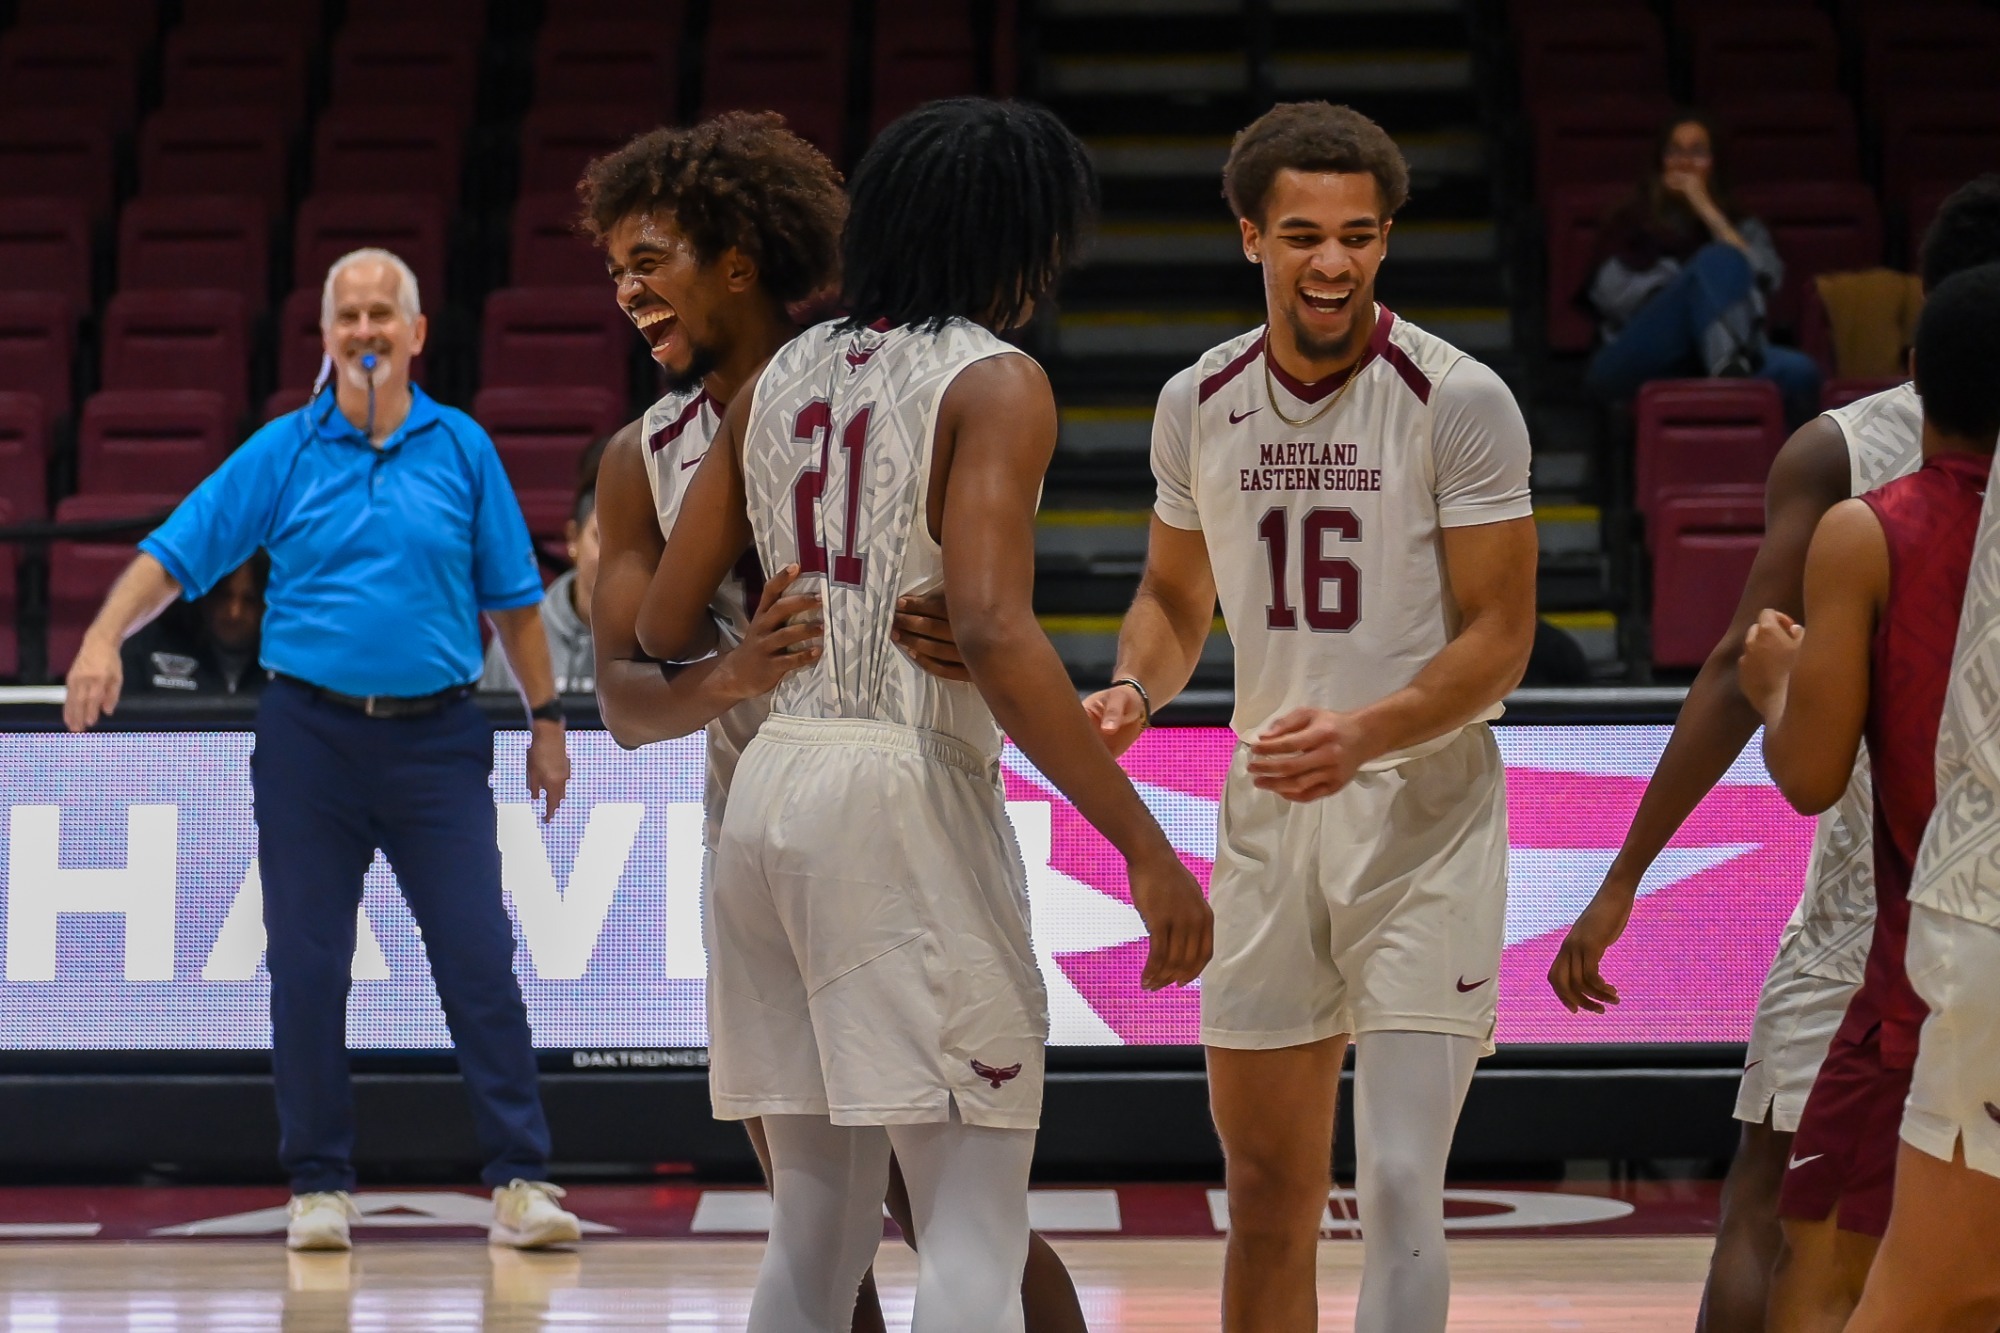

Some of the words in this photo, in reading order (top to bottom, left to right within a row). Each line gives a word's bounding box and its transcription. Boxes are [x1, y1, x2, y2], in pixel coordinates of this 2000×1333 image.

[1260, 442, 1358, 466] MARYLAND
[1241, 467, 1320, 491] EASTERN
[1324, 469, 1381, 491] SHORE
[790, 396, 876, 591] 21
[1257, 505, 1362, 633] 16
[573, 1051, 709, 1067] DAKTRONICS
